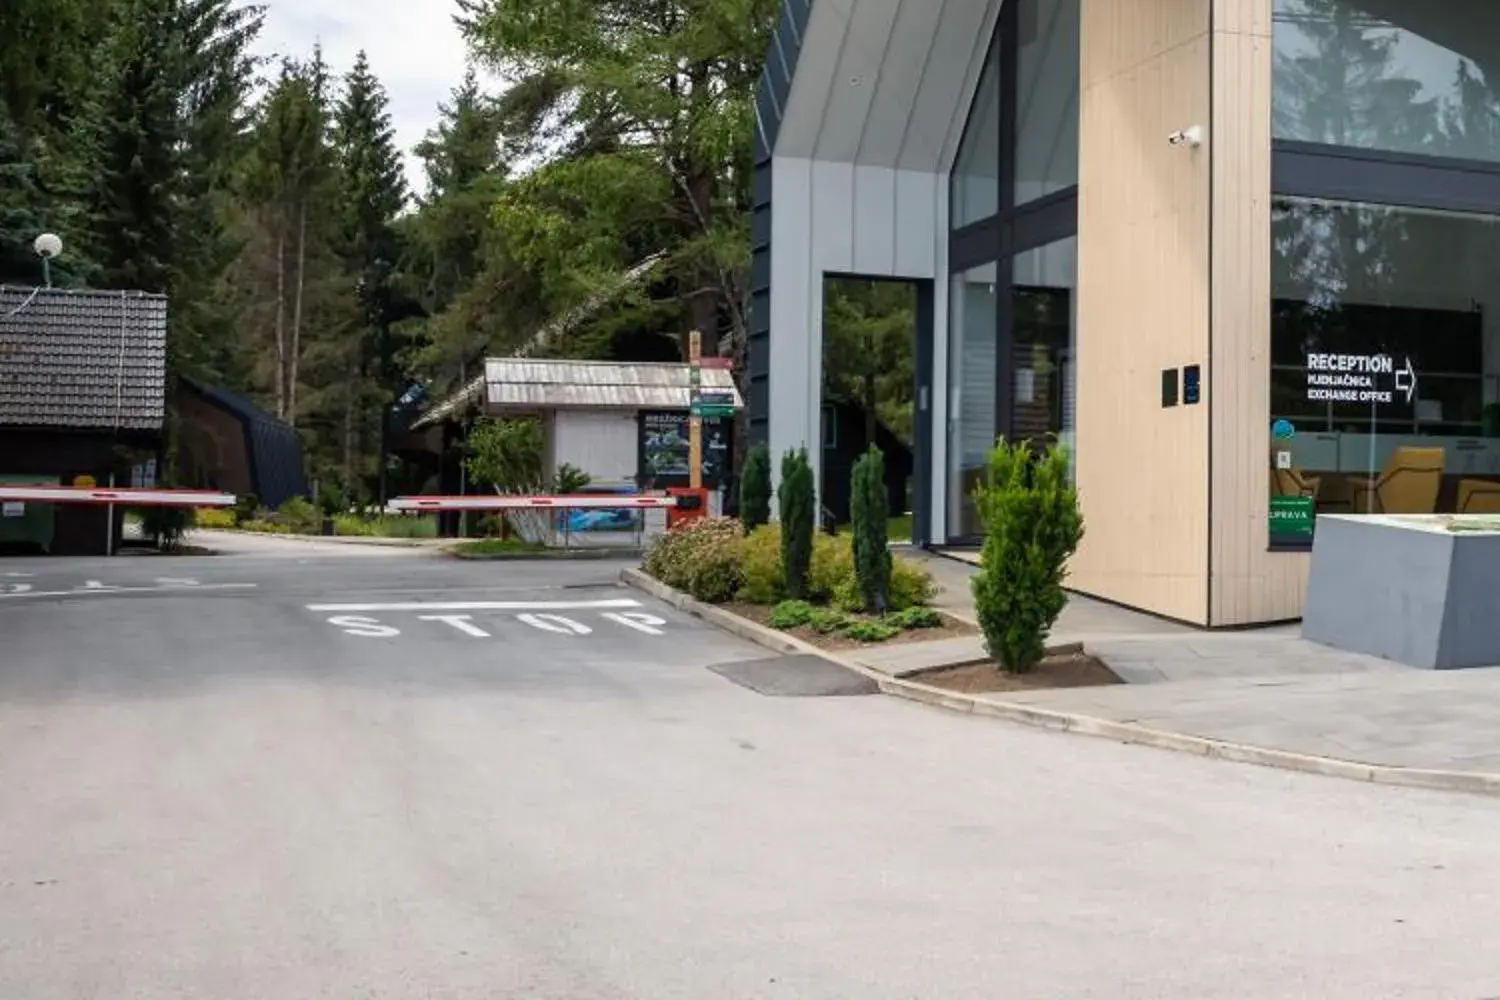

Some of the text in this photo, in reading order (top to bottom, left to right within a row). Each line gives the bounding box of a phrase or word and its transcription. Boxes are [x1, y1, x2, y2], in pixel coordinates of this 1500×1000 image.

[1307, 353, 1393, 373] RECEPTION
[1307, 388, 1393, 403] EXCHANGE OFFICE
[326, 611, 667, 637] STOP
